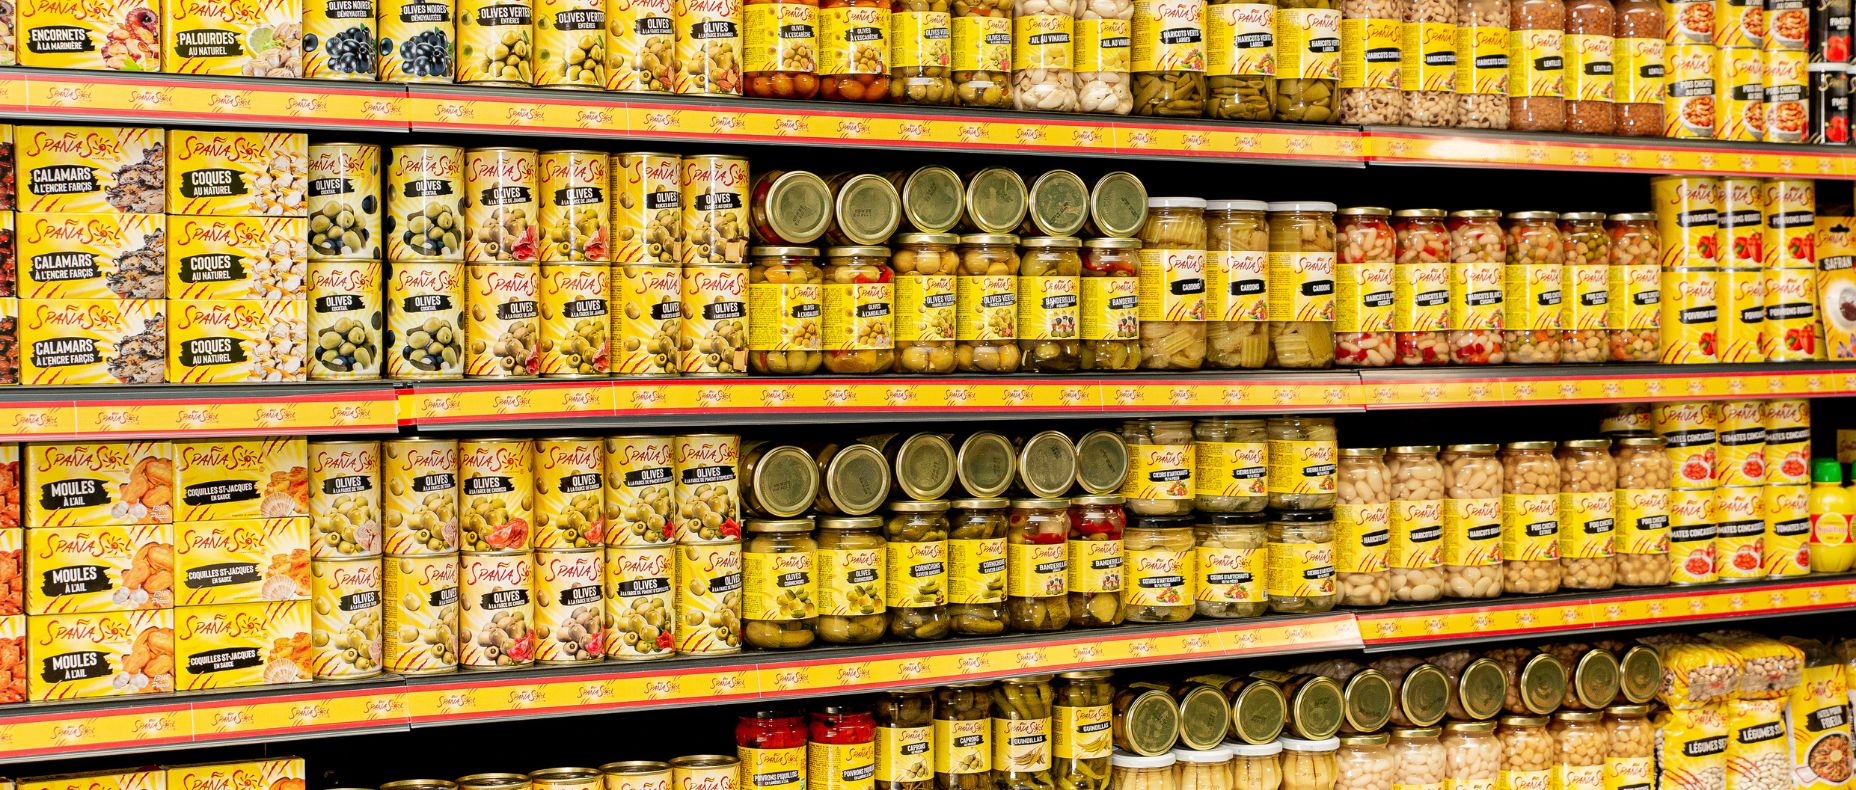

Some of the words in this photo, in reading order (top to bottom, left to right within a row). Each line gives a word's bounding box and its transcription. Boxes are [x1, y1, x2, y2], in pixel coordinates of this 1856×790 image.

[329, 1, 352, 10] OLIVES
[353, 1, 371, 9] NOIRES
[403, 5, 425, 15] OLIVES
[426, 4, 446, 14] NOIRES
[481, 8, 508, 18] OLIVES
[510, 7, 530, 17] VERTES
[558, 12, 585, 24] OLIVES
[648, 18, 669, 29] OLIVES
[703, 22, 729, 33] OLIVES
[32, 28, 86, 42] ENCORNETS
[180, 31, 234, 45] PALOURDES
[37, 41, 42, 50] À
[43, 42, 50, 50] LA
[51, 40, 82, 50] MARINIÈRE
[189, 47, 198, 56] AU
[200, 46, 227, 56] NATUREL
[33, 168, 91, 182] CALAMARS
[192, 171, 232, 184] COQUES
[34, 183, 40, 193] À
[41, 183, 67, 193] L'ENCRE
[316, 179, 341, 190] OLIVES
[415, 181, 442, 192] OLIVES
[194, 186, 202, 196] AU
[204, 185, 232, 194] NATUREL
[566, 188, 593, 199] OLIVES
[34, 254, 92, 269] CALAMARS
[190, 256, 231, 270] COQUES
[35, 270, 41, 280] À
[42, 269, 68, 279] L'ENCRE
[192, 272, 202, 280] AU
[203, 270, 231, 280] NATUREL
[326, 296, 353, 307] OLIVES
[414, 296, 441, 307] OLIVES
[576, 302, 601, 312] OLIVES
[510, 302, 533, 313] OLIVES
[714, 302, 738, 313] OLIVES
[36, 339, 93, 354] CALAMARS
[191, 339, 232, 354] COQUES
[36, 356, 42, 366] À
[42, 356, 68, 366] L'ENCRE
[192, 356, 202, 364] AU
[204, 354, 231, 364] NATUREL
[642, 468, 664, 479] OLIVES
[696, 467, 721, 478] OLIVES
[335, 477, 362, 488] OLIVES
[425, 474, 449, 485] OLIVES
[473, 477, 500, 489] OLIVES
[572, 475, 596, 486] OLIVES
[51, 481, 95, 497] MOULES
[188, 486, 218, 497] COQUILLES
[219, 482, 252, 494] ST-JACQUES
[64, 496, 70, 506] À
[218, 492, 231, 500] SAUCE
[52, 566, 98, 583] MOULES
[188, 569, 220, 580] COQUILLES
[220, 566, 254, 577] ST-JACQUES
[218, 575, 232, 584] SAUCE
[634, 578, 658, 590] OLIVES
[65, 584, 71, 593] À
[573, 586, 596, 598] OLIVES
[353, 592, 374, 604] OLIVES
[494, 591, 520, 603] OLIVES
[52, 653, 97, 670] MOULES
[190, 655, 220, 666] COQUILLES
[222, 650, 256, 662] ST-JACQUES
[220, 660, 234, 668] SAUCE
[65, 670, 72, 679] À
[1743, 726, 1775, 741] LÉGUMES
[1689, 740, 1718, 754] LÉGUMES
